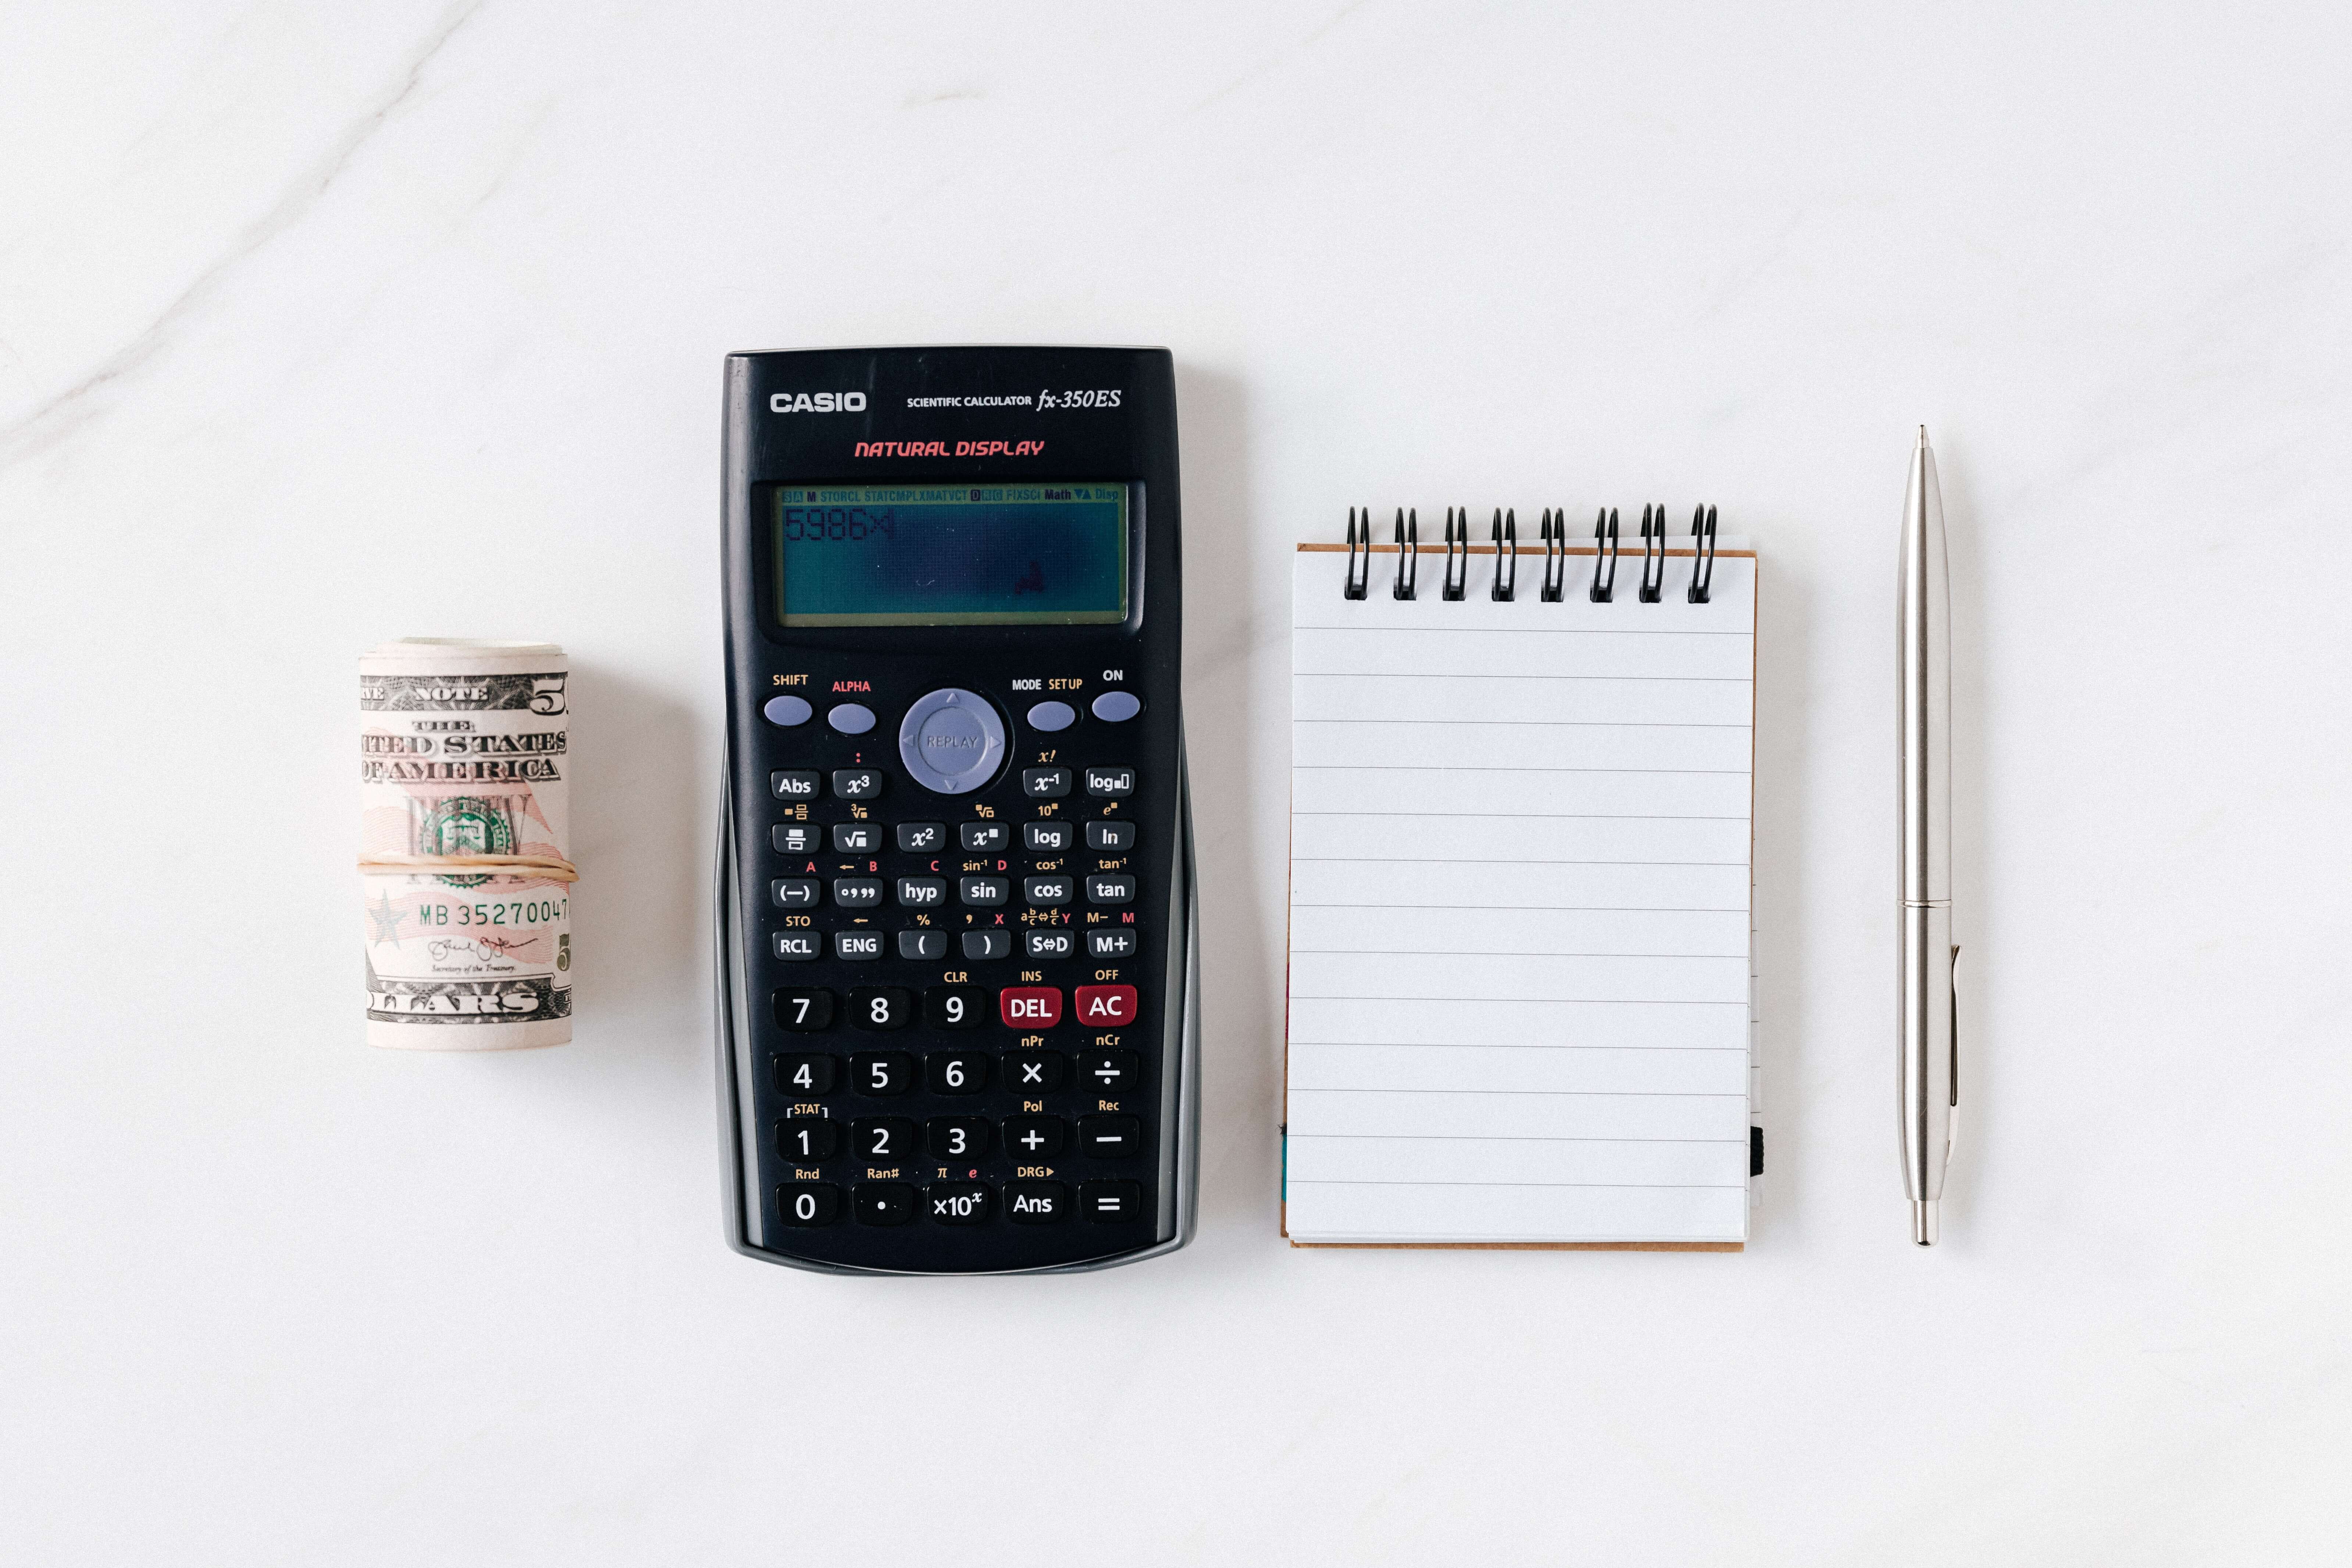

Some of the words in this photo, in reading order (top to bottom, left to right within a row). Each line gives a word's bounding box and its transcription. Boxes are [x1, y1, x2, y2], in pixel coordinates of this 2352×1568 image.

[770, 392, 866, 413] CASIO
[907, 397, 962, 407] SCIENTIFIC
[964, 396, 1032, 406] CALCULATOR
[1036, 389, 1121, 411] fx-350ES
[855, 442, 950, 457] NATURAL
[955, 441, 1044, 456] DISPLAY
[1045, 488, 1072, 500] Math
[773, 674, 808, 685] SHIFT
[1103, 670, 1123, 681] ON
[832, 681, 871, 692] ALPHA
[1012, 679, 1041, 690] MODE
[414, 685, 489, 702] NOTE
[530, 677, 565, 716] 5
[444, 731, 567, 756] STATES
[927, 737, 977, 749] REPLAY
[387, 758, 561, 784] AMERICA
[779, 778, 811, 793] Abs
[1034, 828, 1061, 847] log
[1103, 829, 1118, 844] ln
[806, 862, 816, 872] A
[870, 861, 877, 872] B
[931, 860, 939, 871] C
[998, 860, 1007, 870] D
[906, 883, 937, 902] hyp
[971, 882, 996, 898] sin
[1034, 885, 1062, 897] cos
[1096, 883, 1125, 897] tan
[419, 903, 449, 926] MB
[458, 899, 567, 926] 35270047
[995, 914, 1004, 924] X
[1062, 913, 1070, 923] Y
[1122, 912, 1134, 923] M
[786, 916, 810, 926] STO
[781, 939, 812, 953] RCL
[842, 938, 876, 952] ENG
[1097, 937, 1128, 952] M+
[944, 972, 967, 983] CLR
[1022, 971, 1042, 981] INS
[1095, 970, 1118, 980] OFF
[792, 999, 810, 1023] 7
[871, 997, 889, 1023] 8
[946, 997, 963, 1022] 9
[1011, 999, 1052, 1017] DEL
[1089, 996, 1122, 1016] AC
[1022, 1036, 1044, 1047] nPr
[1096, 1034, 1120, 1045] nCr
[793, 1064, 812, 1088] 4
[872, 1063, 888, 1088] 5
[946, 1061, 964, 1087] 6
[794, 1104, 820, 1114] STAT
[1024, 1100, 1042, 1112] Pol
[1099, 1100, 1119, 1111] Rec
[798, 1130, 809, 1155] 1
[872, 1128, 889, 1154] 2
[949, 1128, 966, 1154] 3
[796, 1168, 819, 1179] Rnd
[867, 1168, 899, 1179] Ran#
[969, 1169, 977, 1178] e
[796, 1194, 815, 1219] 0
[1013, 1195, 1052, 1212] Ans
